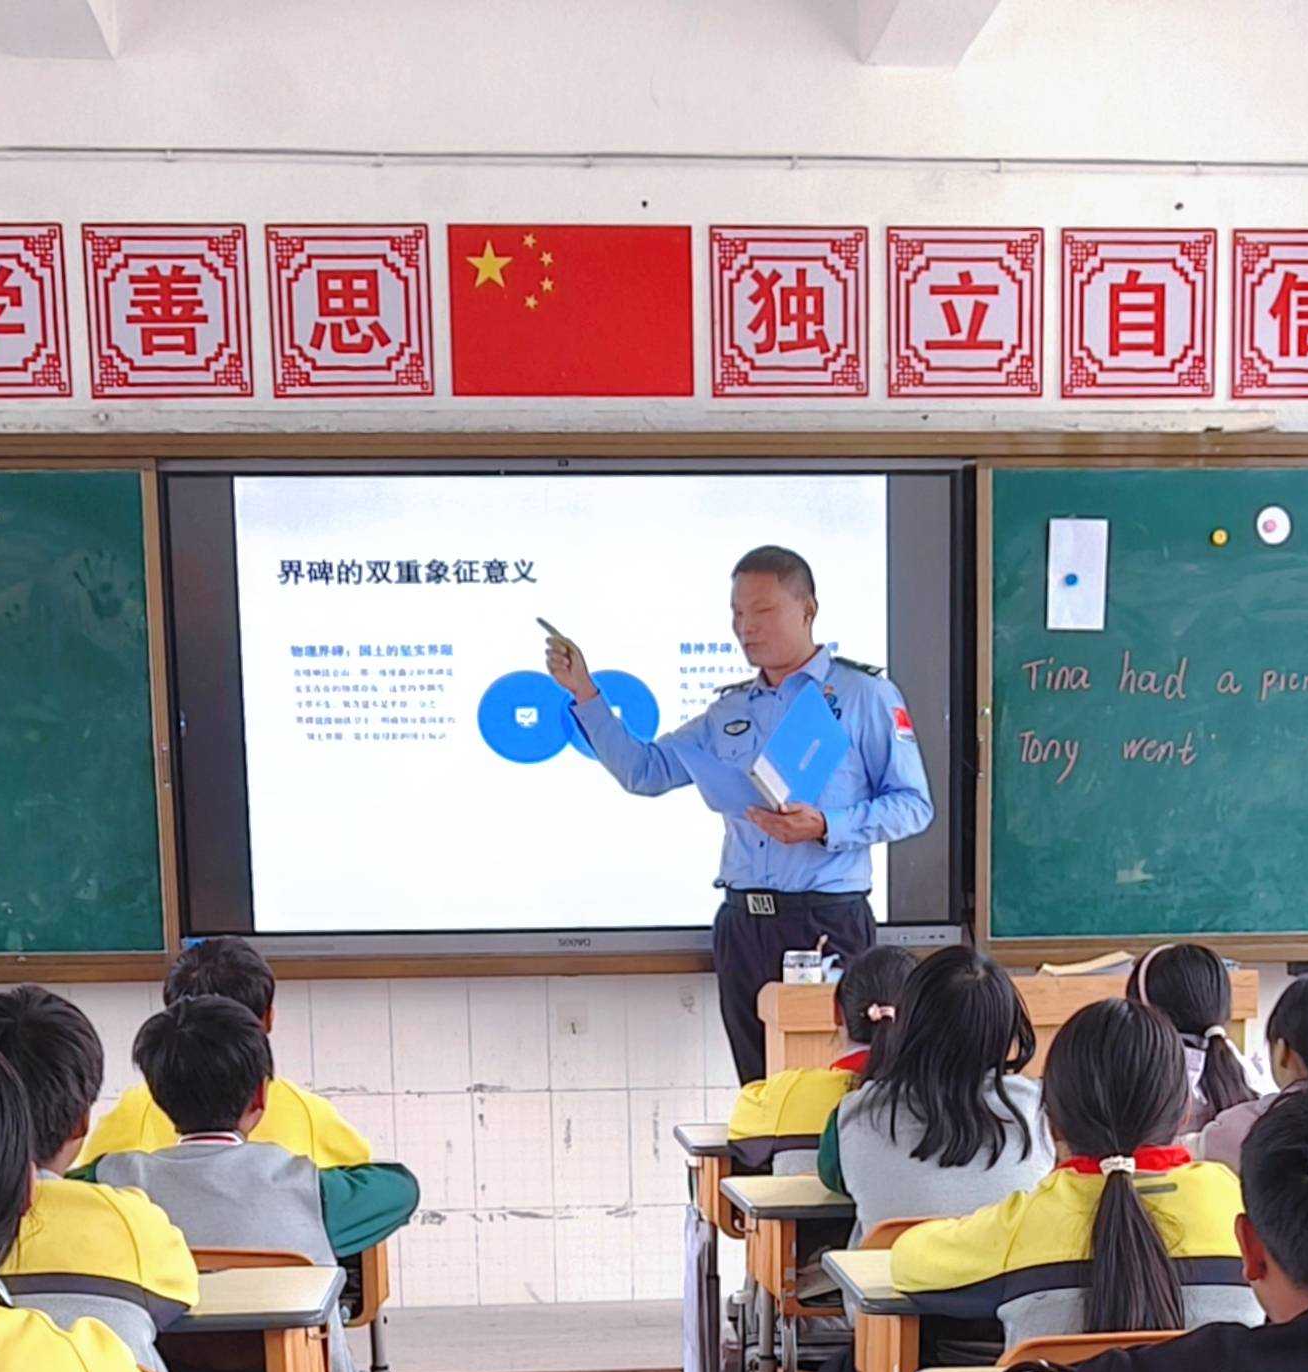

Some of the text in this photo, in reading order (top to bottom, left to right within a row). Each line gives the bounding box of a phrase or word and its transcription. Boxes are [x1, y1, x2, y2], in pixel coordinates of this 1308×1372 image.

[277, 558, 537, 586] 界碑的双重象征意义
[1023, 658, 1091, 691] Tina
[1119, 651, 1188, 700] had
[1216, 671, 1242, 695] a
[1020, 731, 1197, 784] Tony went
